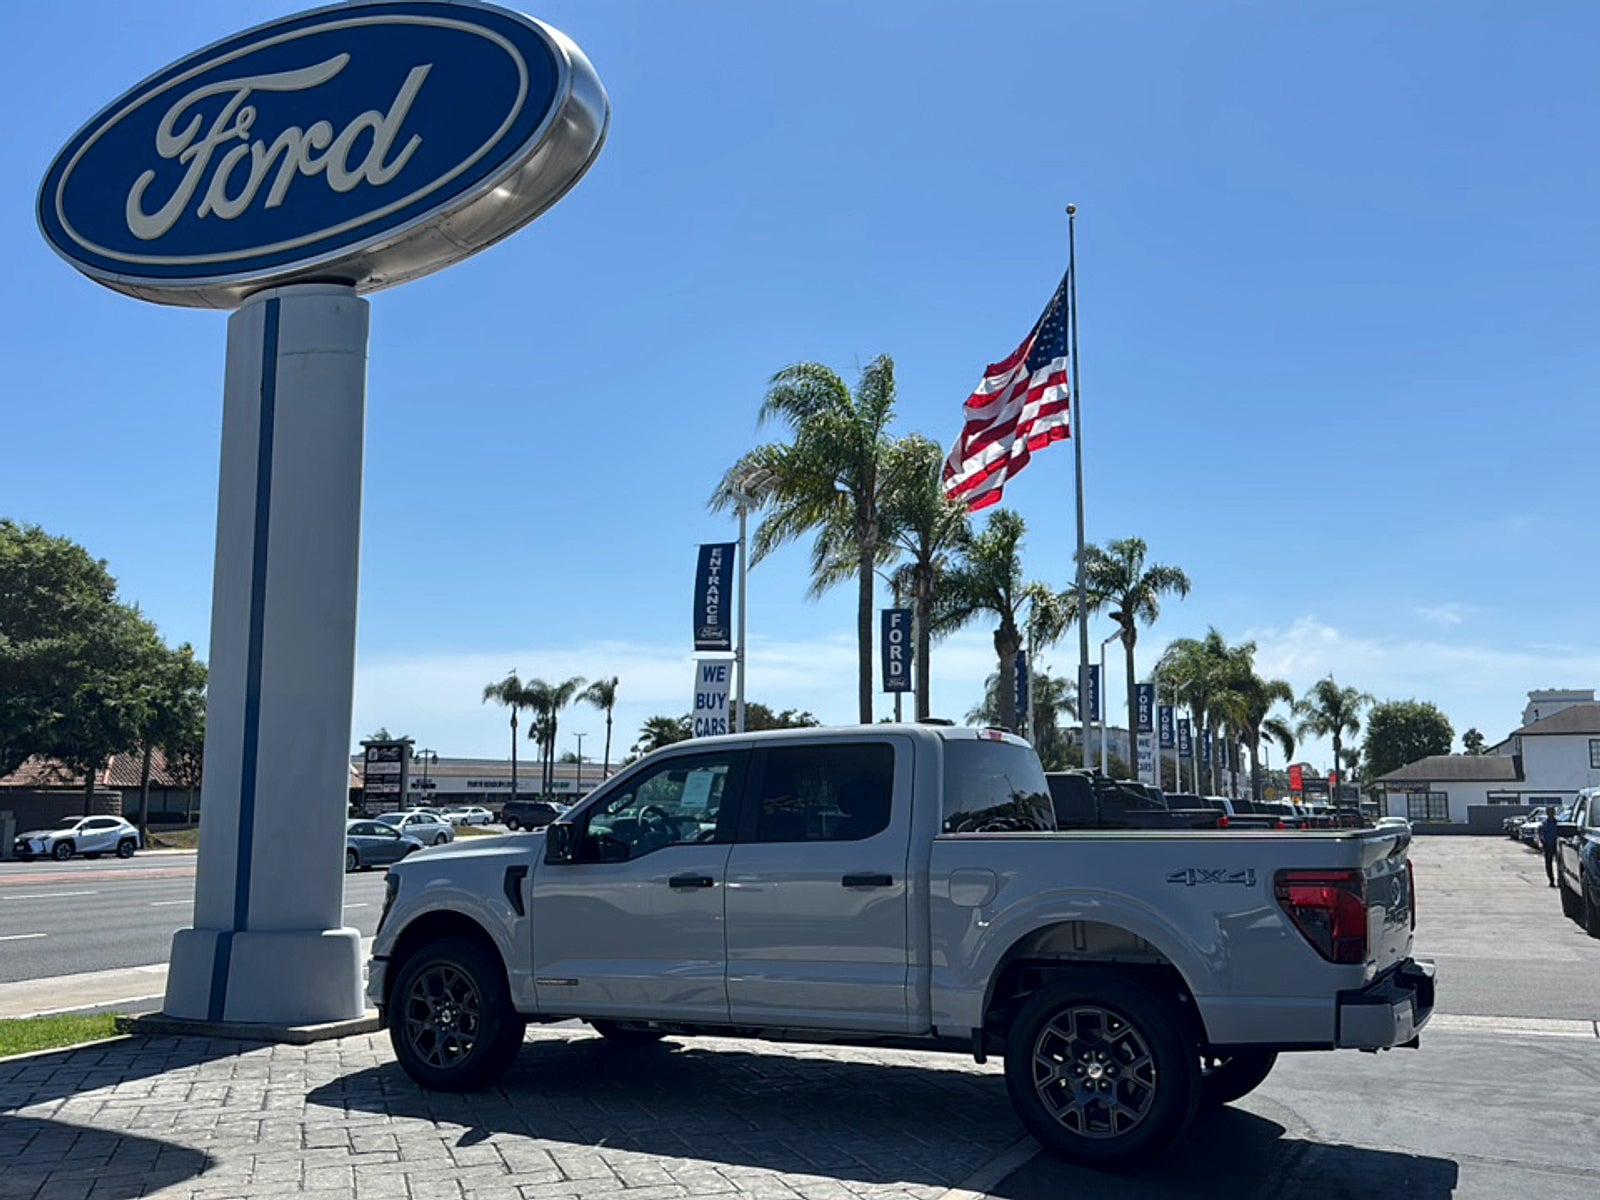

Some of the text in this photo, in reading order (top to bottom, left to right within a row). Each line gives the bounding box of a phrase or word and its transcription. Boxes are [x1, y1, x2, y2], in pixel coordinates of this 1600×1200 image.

[125, 52, 433, 241] Ford
[706, 548, 723, 625] ENTRANCE
[889, 613, 903, 676] FORD
[703, 664, 726, 683] WE
[696, 693, 726, 710] BUY
[1138, 686, 1149, 723] FORD
[695, 717, 726, 737] CARS
[1161, 707, 1170, 740] FORD
[1180, 721, 1189, 750] FORD
